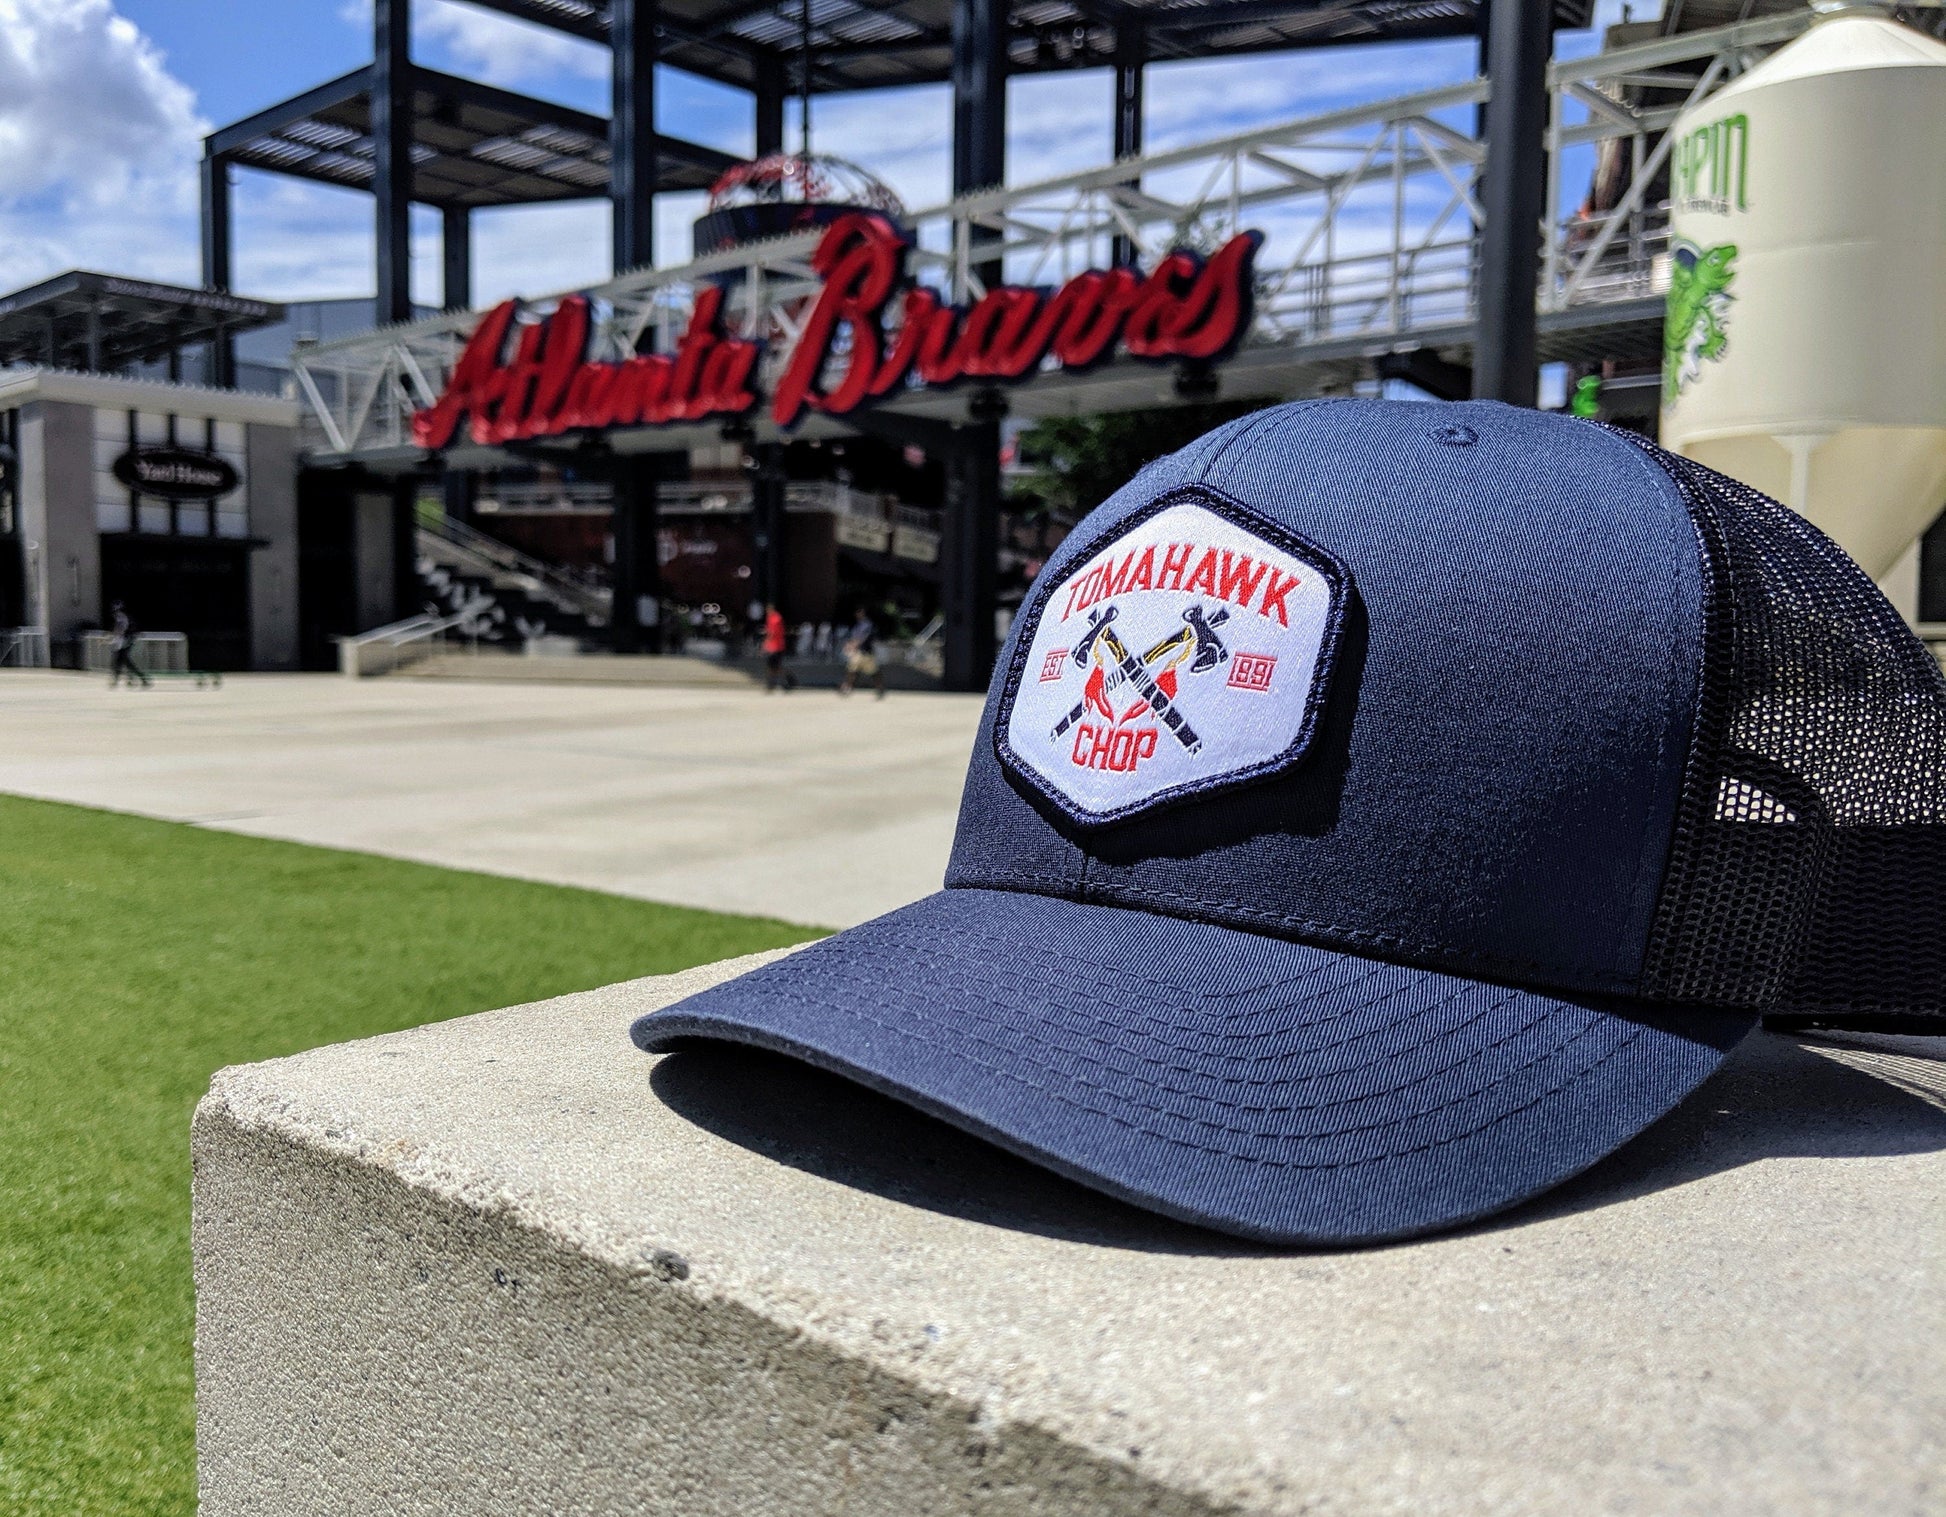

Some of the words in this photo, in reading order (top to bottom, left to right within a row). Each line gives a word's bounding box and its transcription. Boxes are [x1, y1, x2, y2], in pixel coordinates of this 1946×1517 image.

[411, 293, 760, 450] Atlanta
[771, 211, 1263, 430] Braves
[1060, 543, 1301, 628] TOMAHAWK
[1041, 652, 1067, 678] EST
[1072, 724, 1158, 772] CHOP
